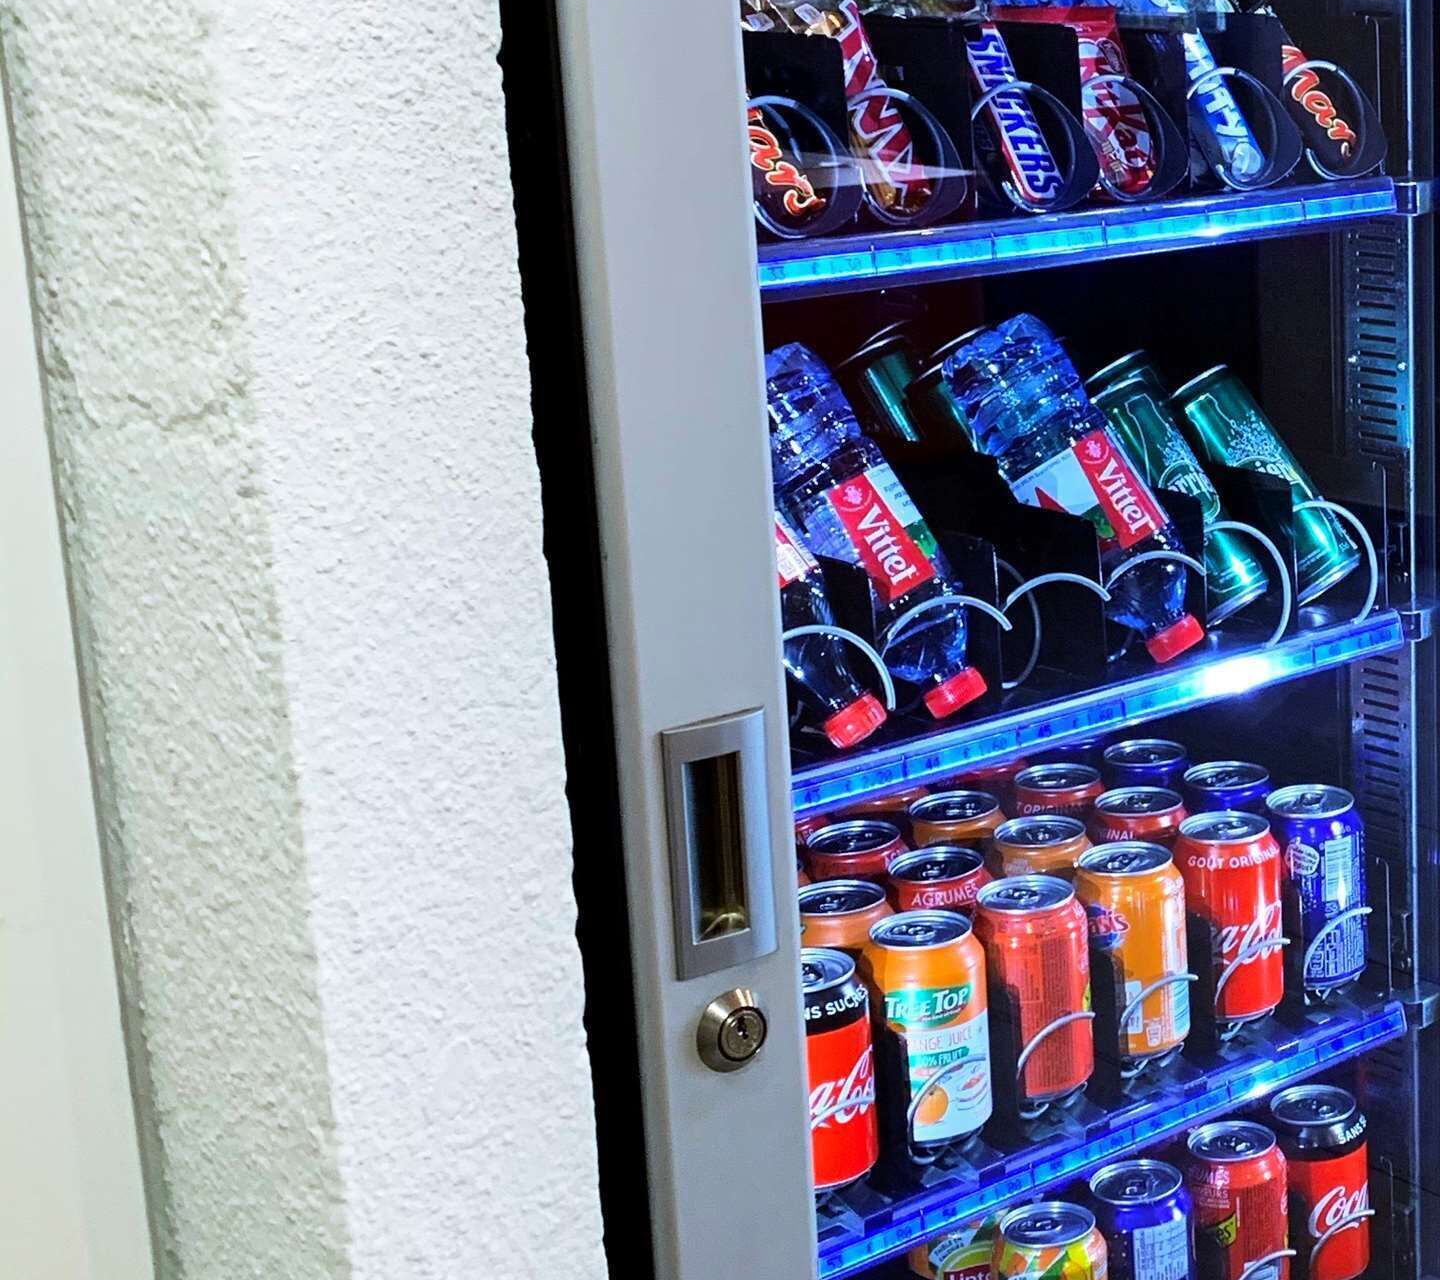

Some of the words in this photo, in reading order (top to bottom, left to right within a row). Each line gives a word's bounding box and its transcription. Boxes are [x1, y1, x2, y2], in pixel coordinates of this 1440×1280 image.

[966, 30, 1064, 200] SNICKERS
[1098, 457, 1156, 536] Vittel
[857, 503, 918, 586] Vittel
[1229, 844, 1280, 868] ORIGINAL
[911, 884, 980, 907] AGRUMES
[885, 996, 932, 1020] TREE
[934, 986, 970, 1014] TOP
